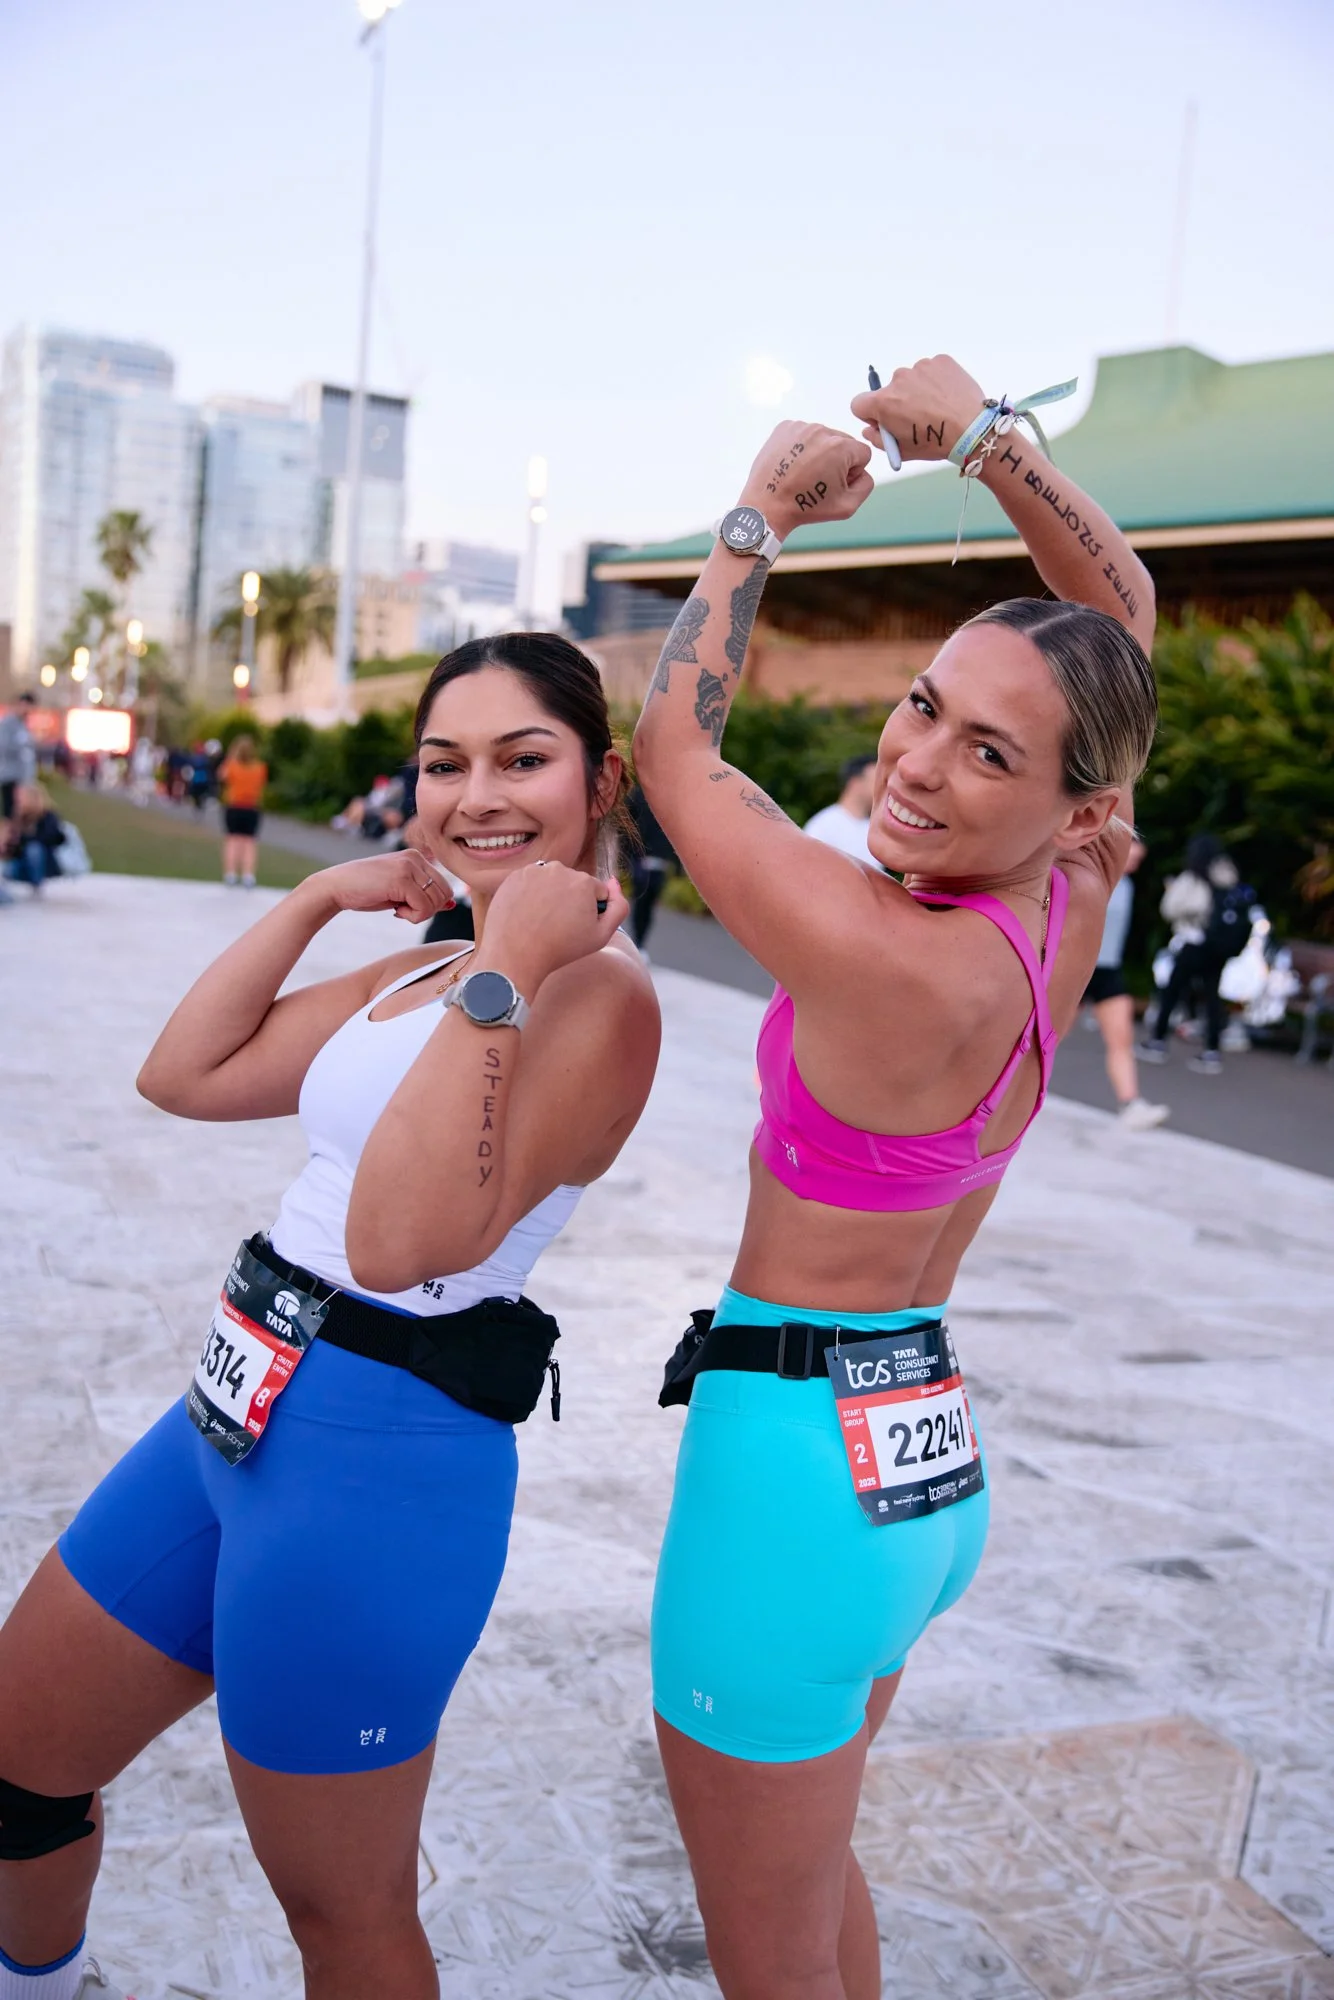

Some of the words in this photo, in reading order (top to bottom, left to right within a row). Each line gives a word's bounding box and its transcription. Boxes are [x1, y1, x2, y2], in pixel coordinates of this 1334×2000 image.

[911, 420, 945, 447] IN
[794, 481, 828, 512] RIP
[1000, 445, 1022, 474] I
[1024, 469, 1103, 558] BELONG
[1102, 562, 1140, 619] HERE
[478, 1047, 503, 1188] STEADY
[265, 1310, 293, 1338] TATA
[276, 1354, 294, 1369] CHUTE
[892, 1348, 919, 1360] TATA
[895, 1354, 939, 1371] CONSULTANCY
[272, 1362, 290, 1377] ENTRY
[845, 1358, 892, 1389] tcs
[896, 1367, 931, 1382] SERVICES
[255, 1387, 271, 1408] B
[842, 1408, 862, 1418] START
[844, 1417, 865, 1427] GROUP
[888, 1407, 966, 1468] 22241
[853, 1443, 869, 1464] 2
[858, 1477, 876, 1488] 2025
